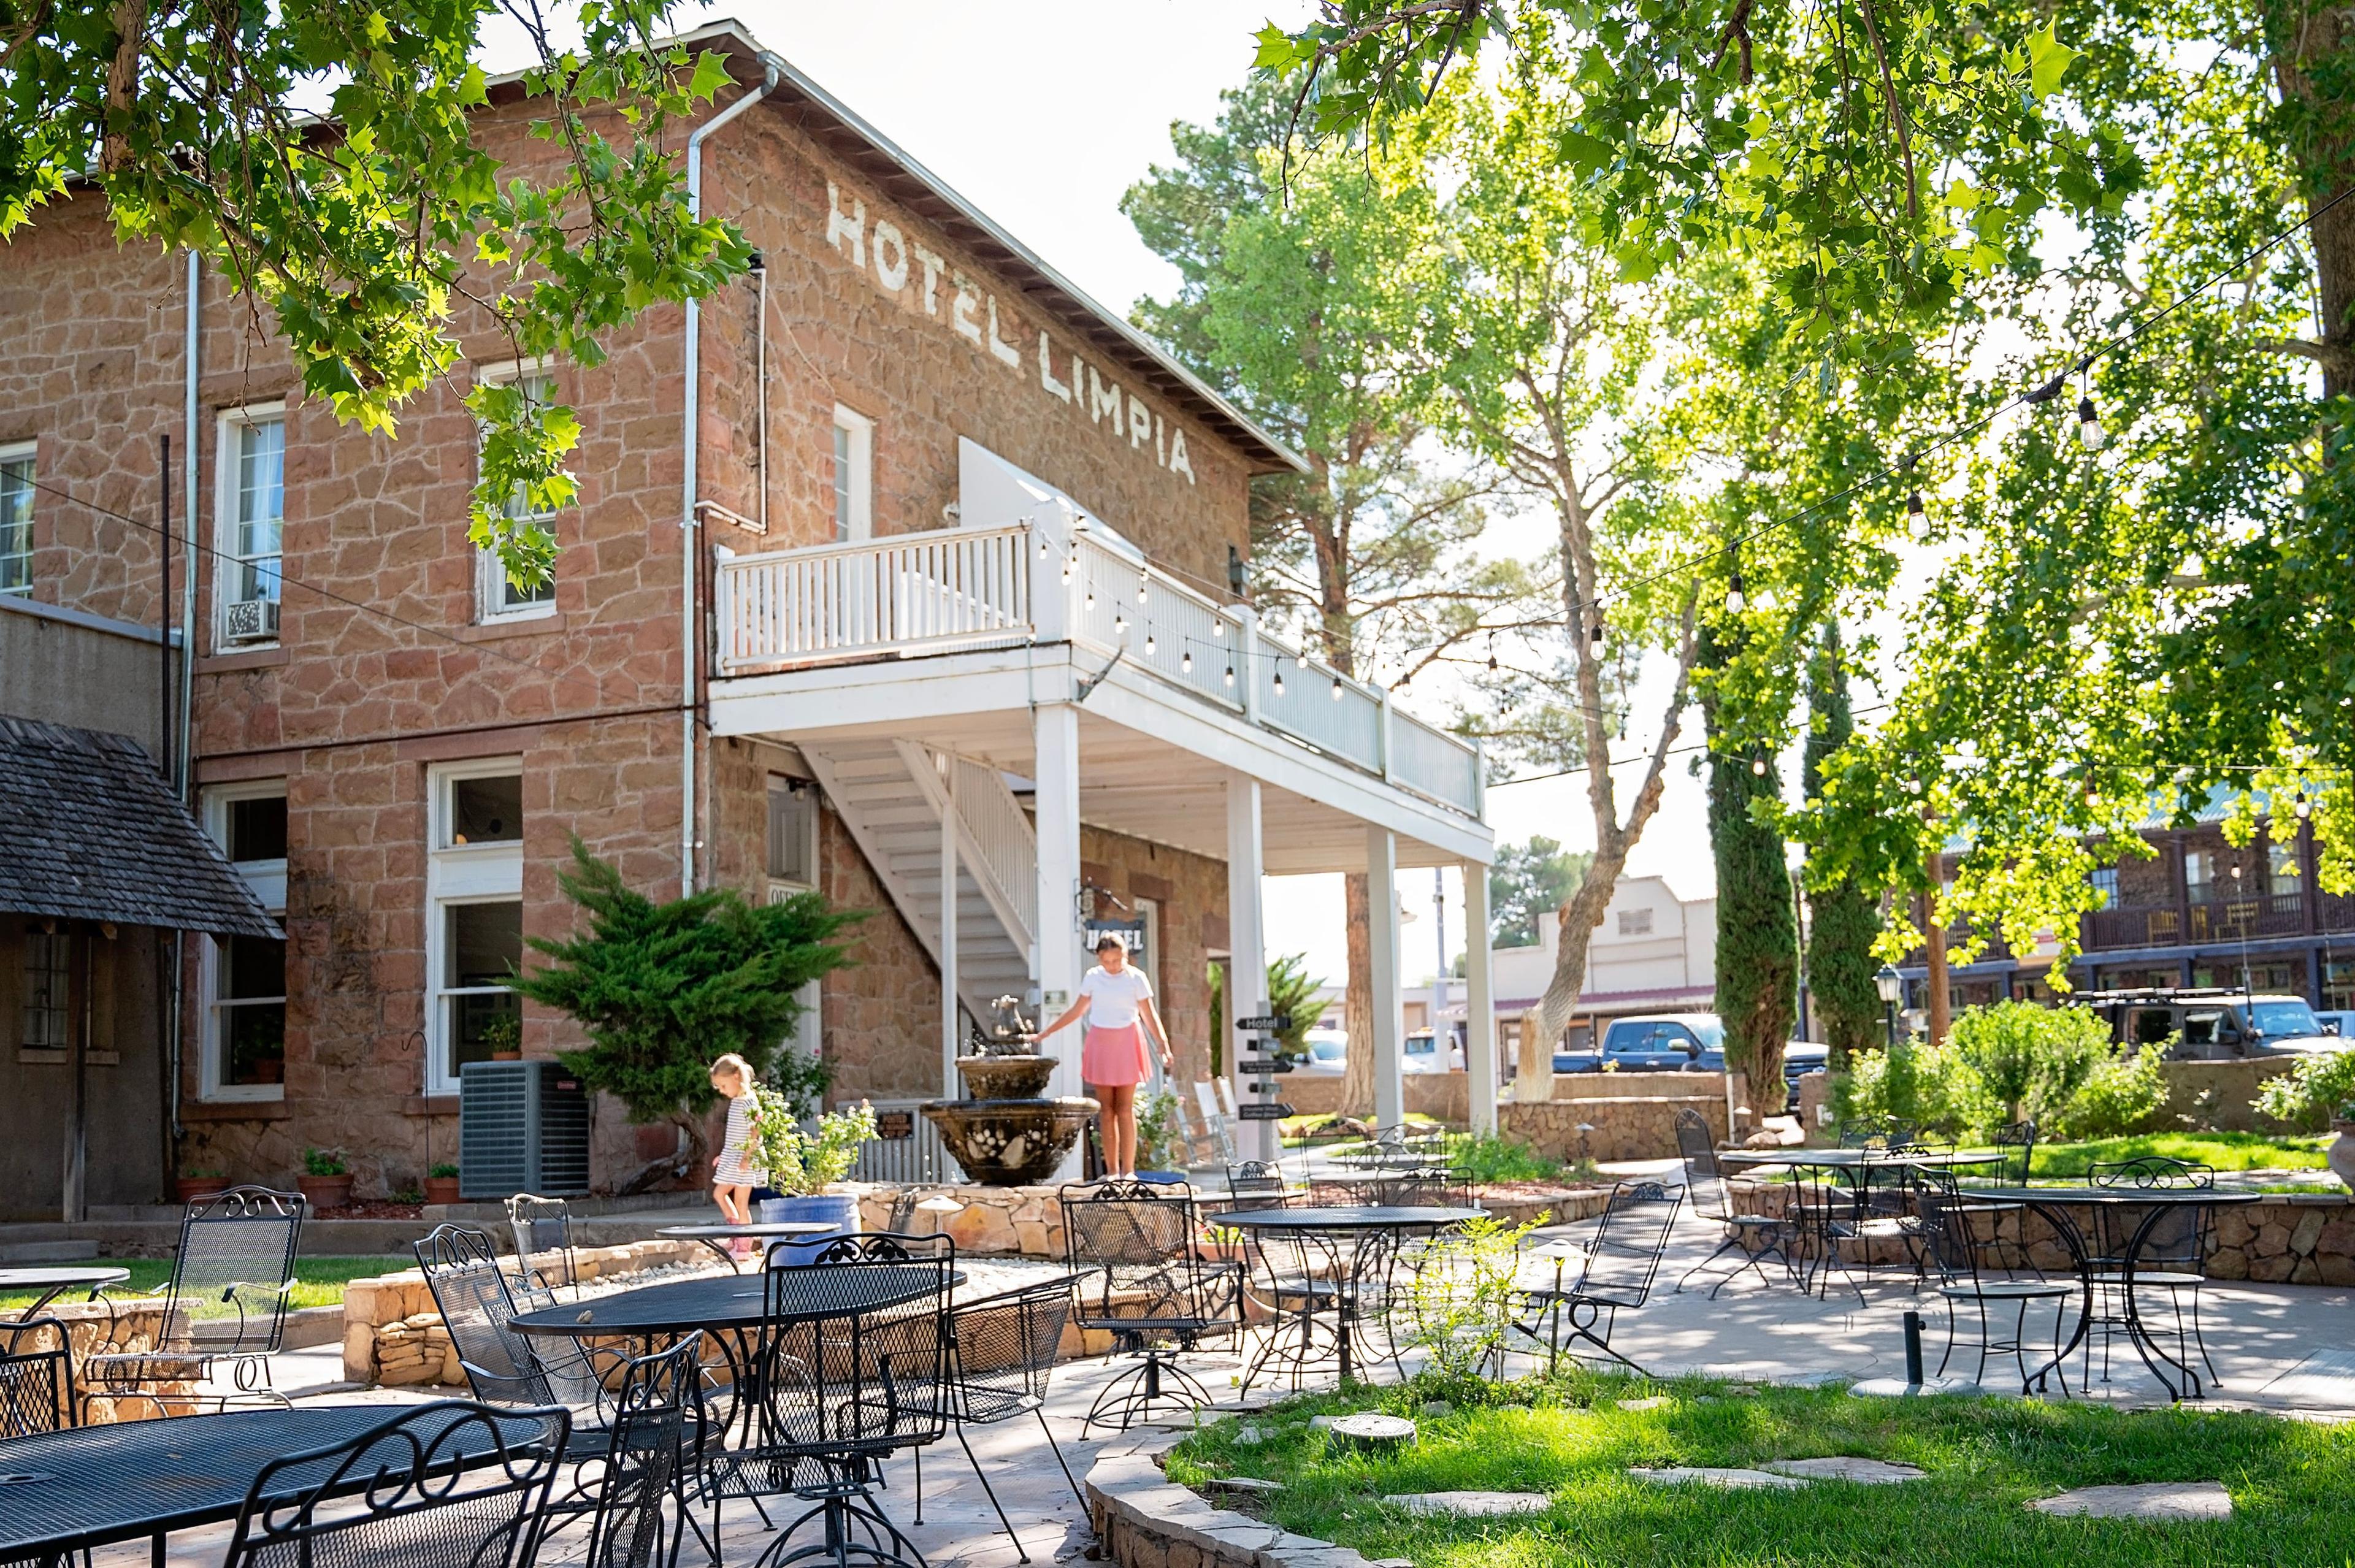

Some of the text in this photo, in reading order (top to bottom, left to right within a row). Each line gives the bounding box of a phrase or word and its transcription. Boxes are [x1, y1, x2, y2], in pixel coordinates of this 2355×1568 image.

[826, 179, 1195, 486] HOTEL LIMPIA
[1246, 1017, 1277, 1028] Hotel
